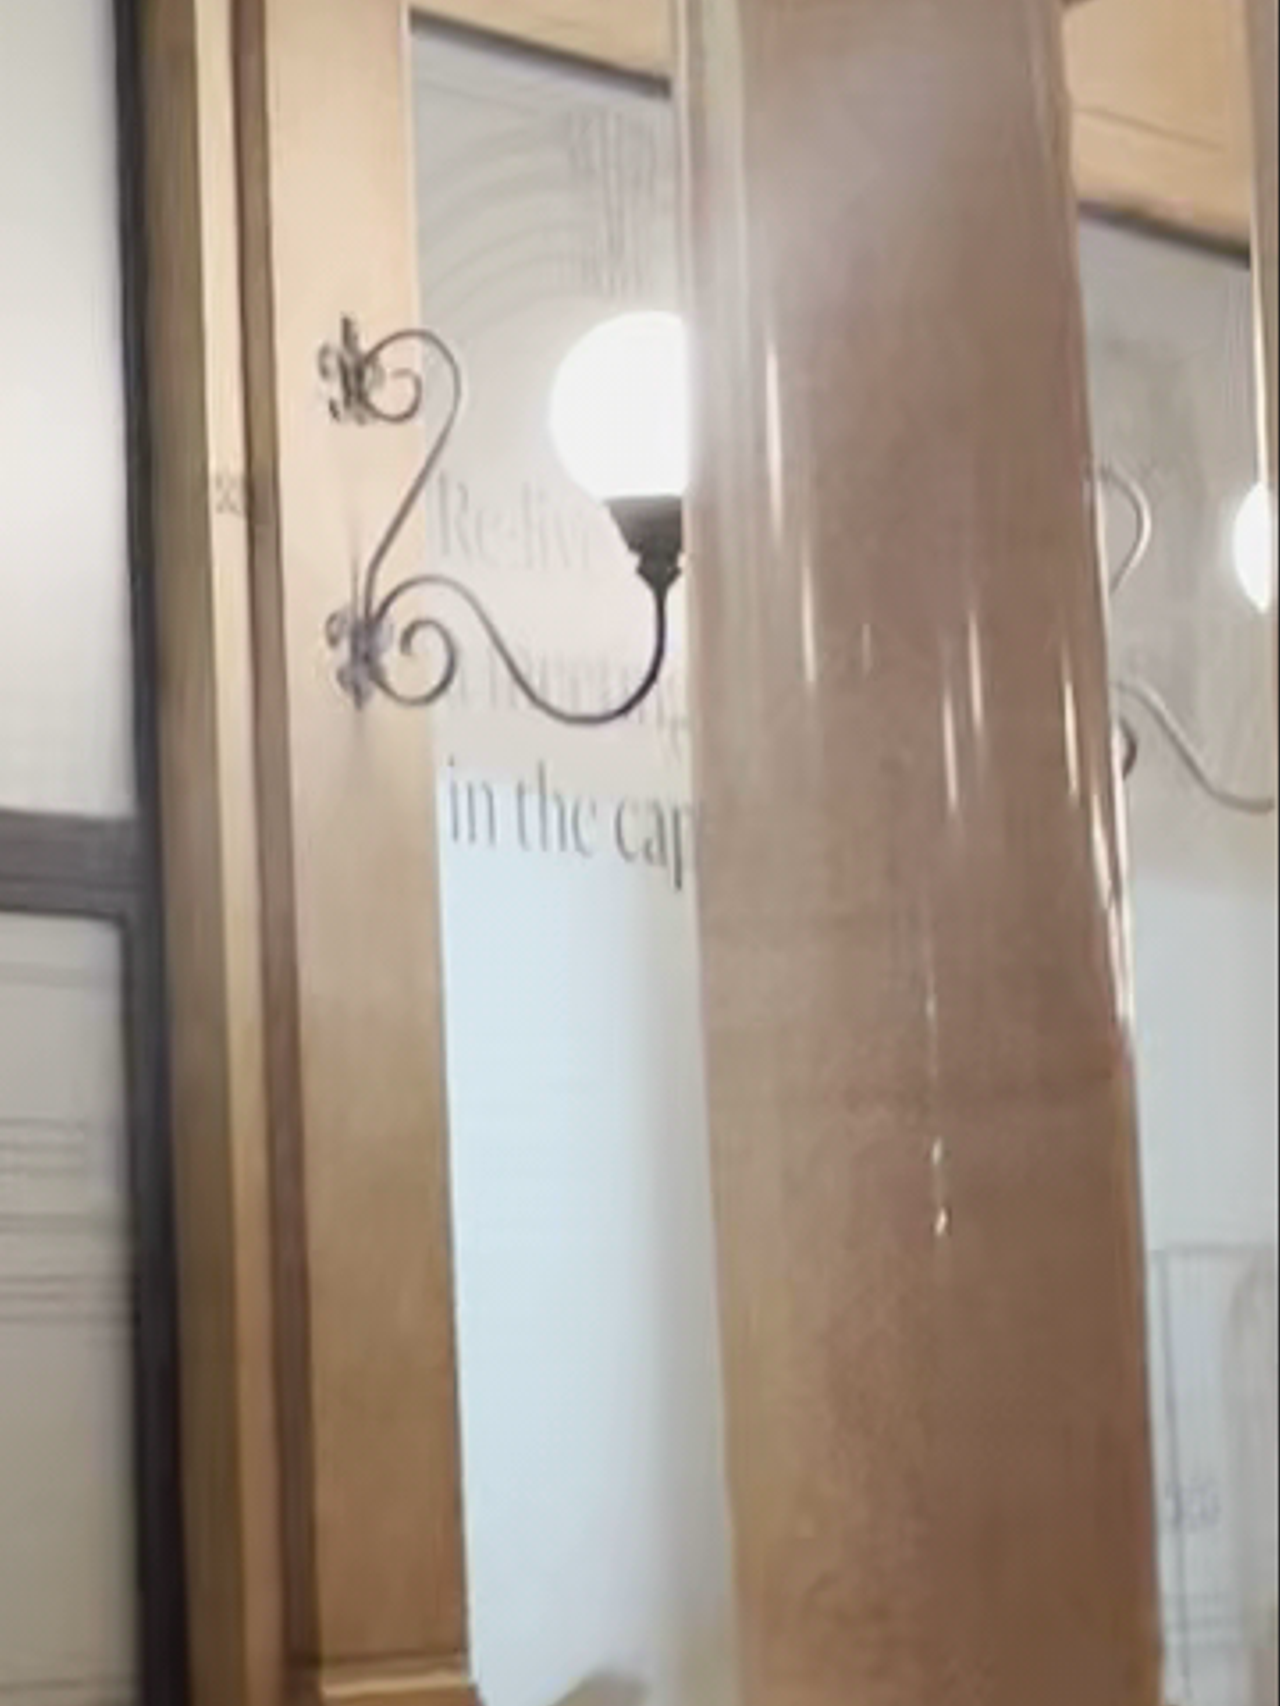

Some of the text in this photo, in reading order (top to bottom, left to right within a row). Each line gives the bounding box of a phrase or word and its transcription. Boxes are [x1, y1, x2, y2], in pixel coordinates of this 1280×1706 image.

[446, 755, 693, 892] in the cap
